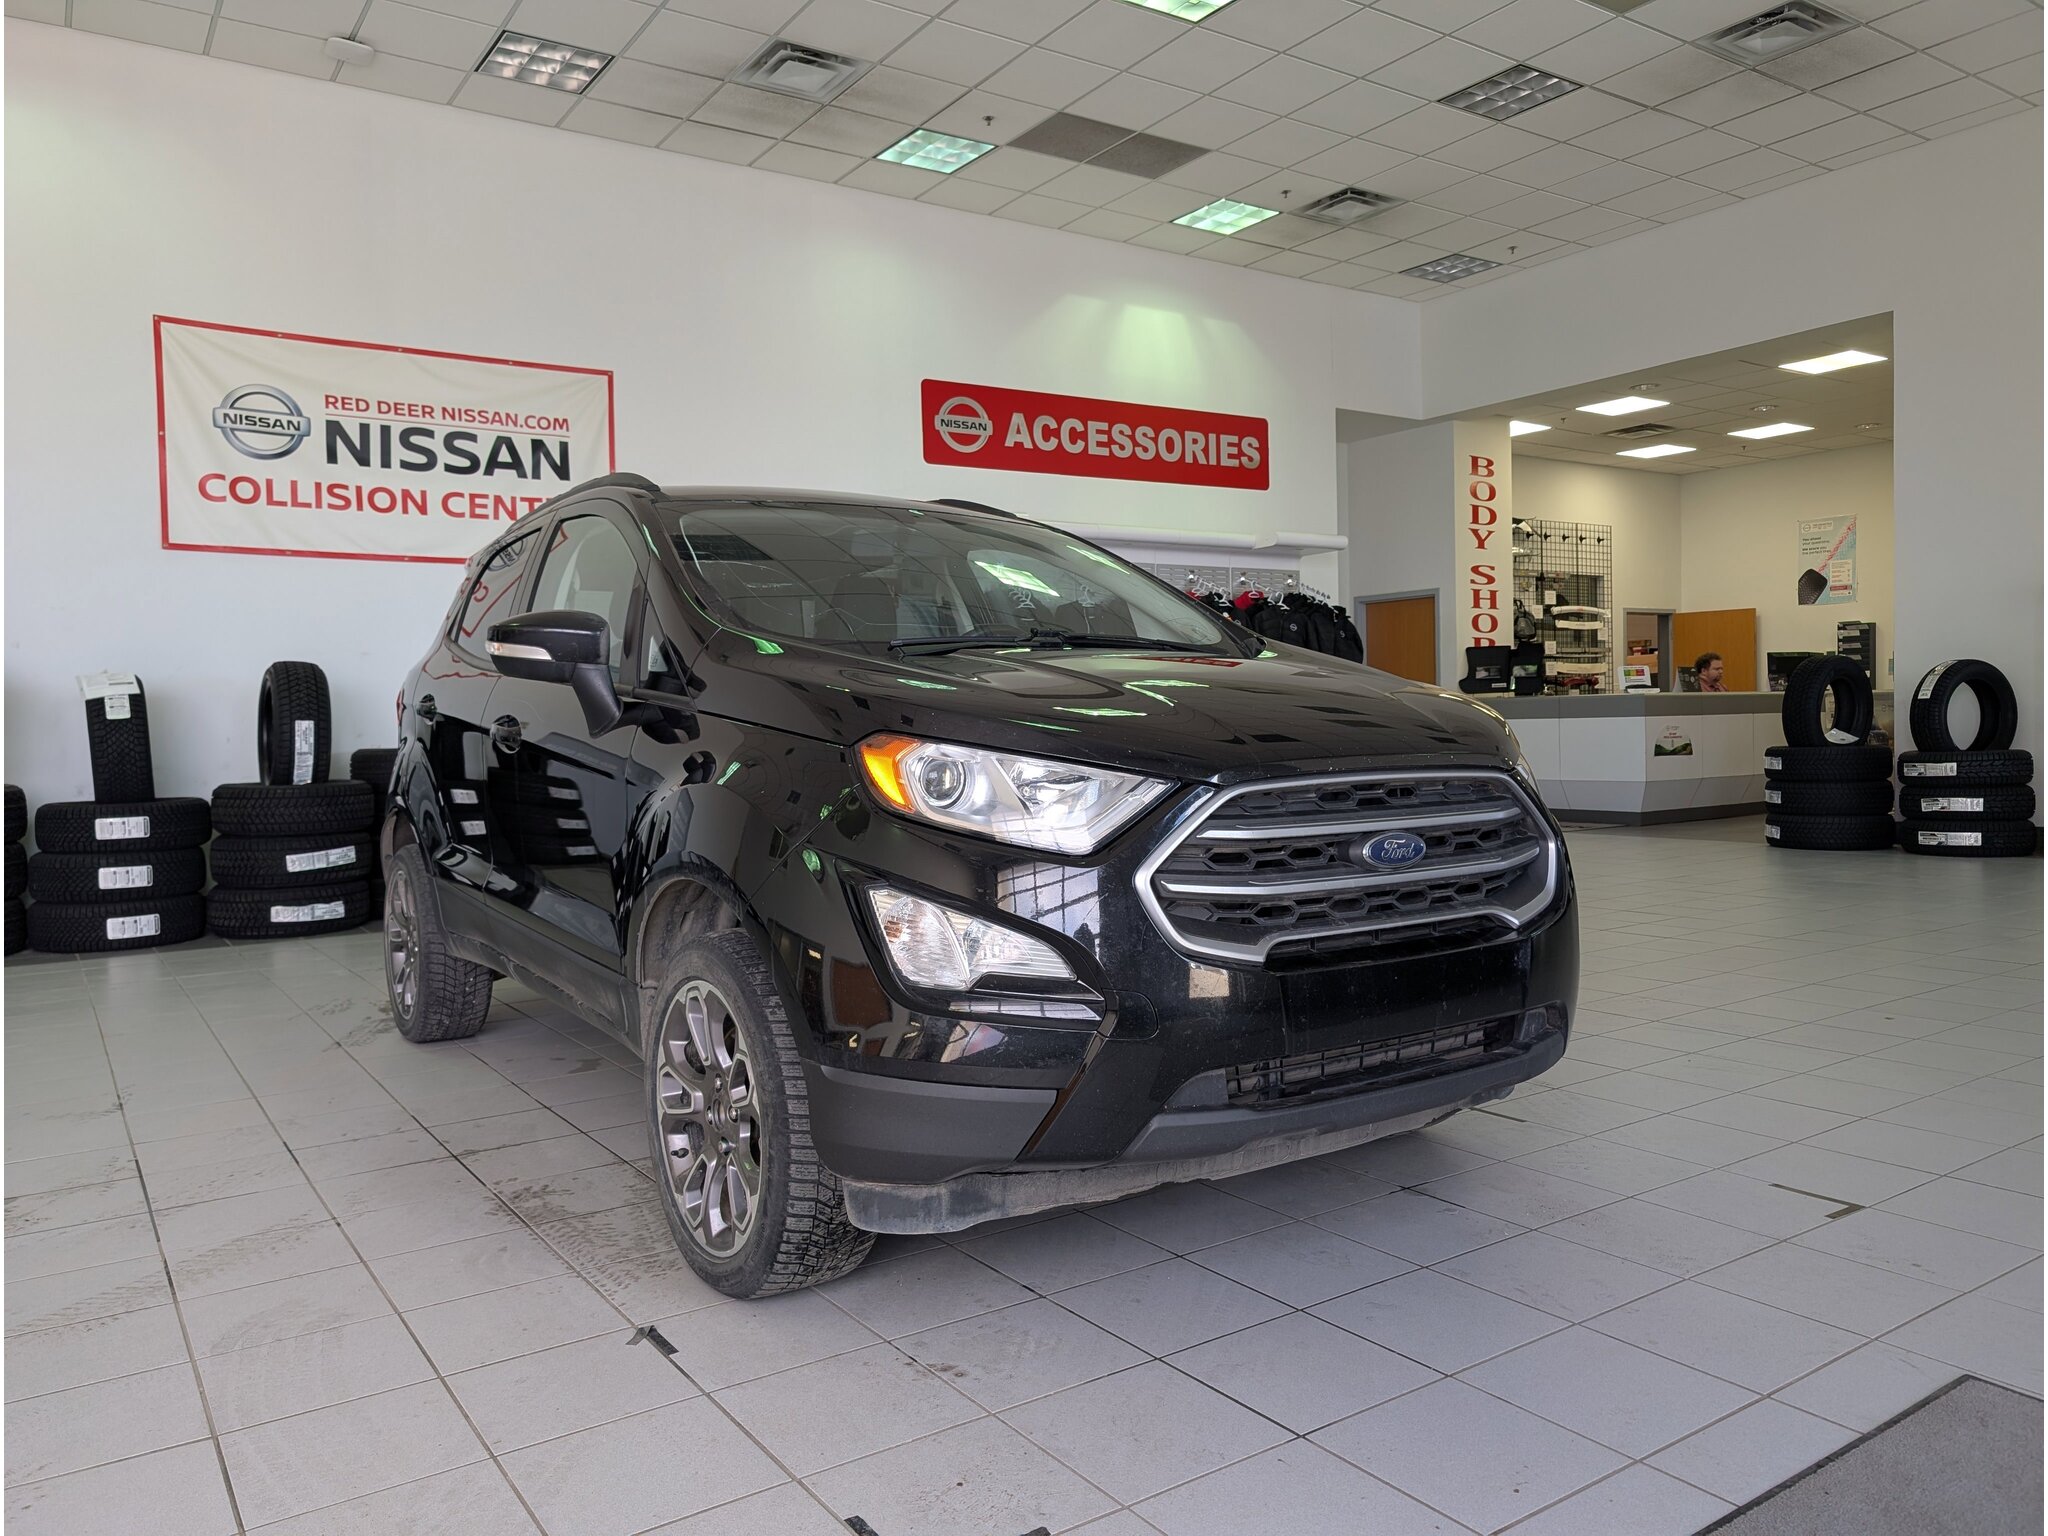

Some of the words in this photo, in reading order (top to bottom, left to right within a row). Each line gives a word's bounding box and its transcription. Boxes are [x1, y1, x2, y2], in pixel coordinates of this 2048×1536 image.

[223, 412, 301, 431] NISSAN
[324, 394, 370, 412] RED
[376, 400, 435, 419] DEER
[441, 406, 570, 432] NISSAN.COM
[940, 418, 987, 431] NISSAN
[325, 419, 571, 481] NISSAN
[1004, 412, 1261, 470] ACCESSORIES
[198, 473, 429, 516] COLLISION
[441, 491, 552, 522] CENT
[1468, 454, 1498, 550] BODY
[1381, 839, 1415, 861] Ford
